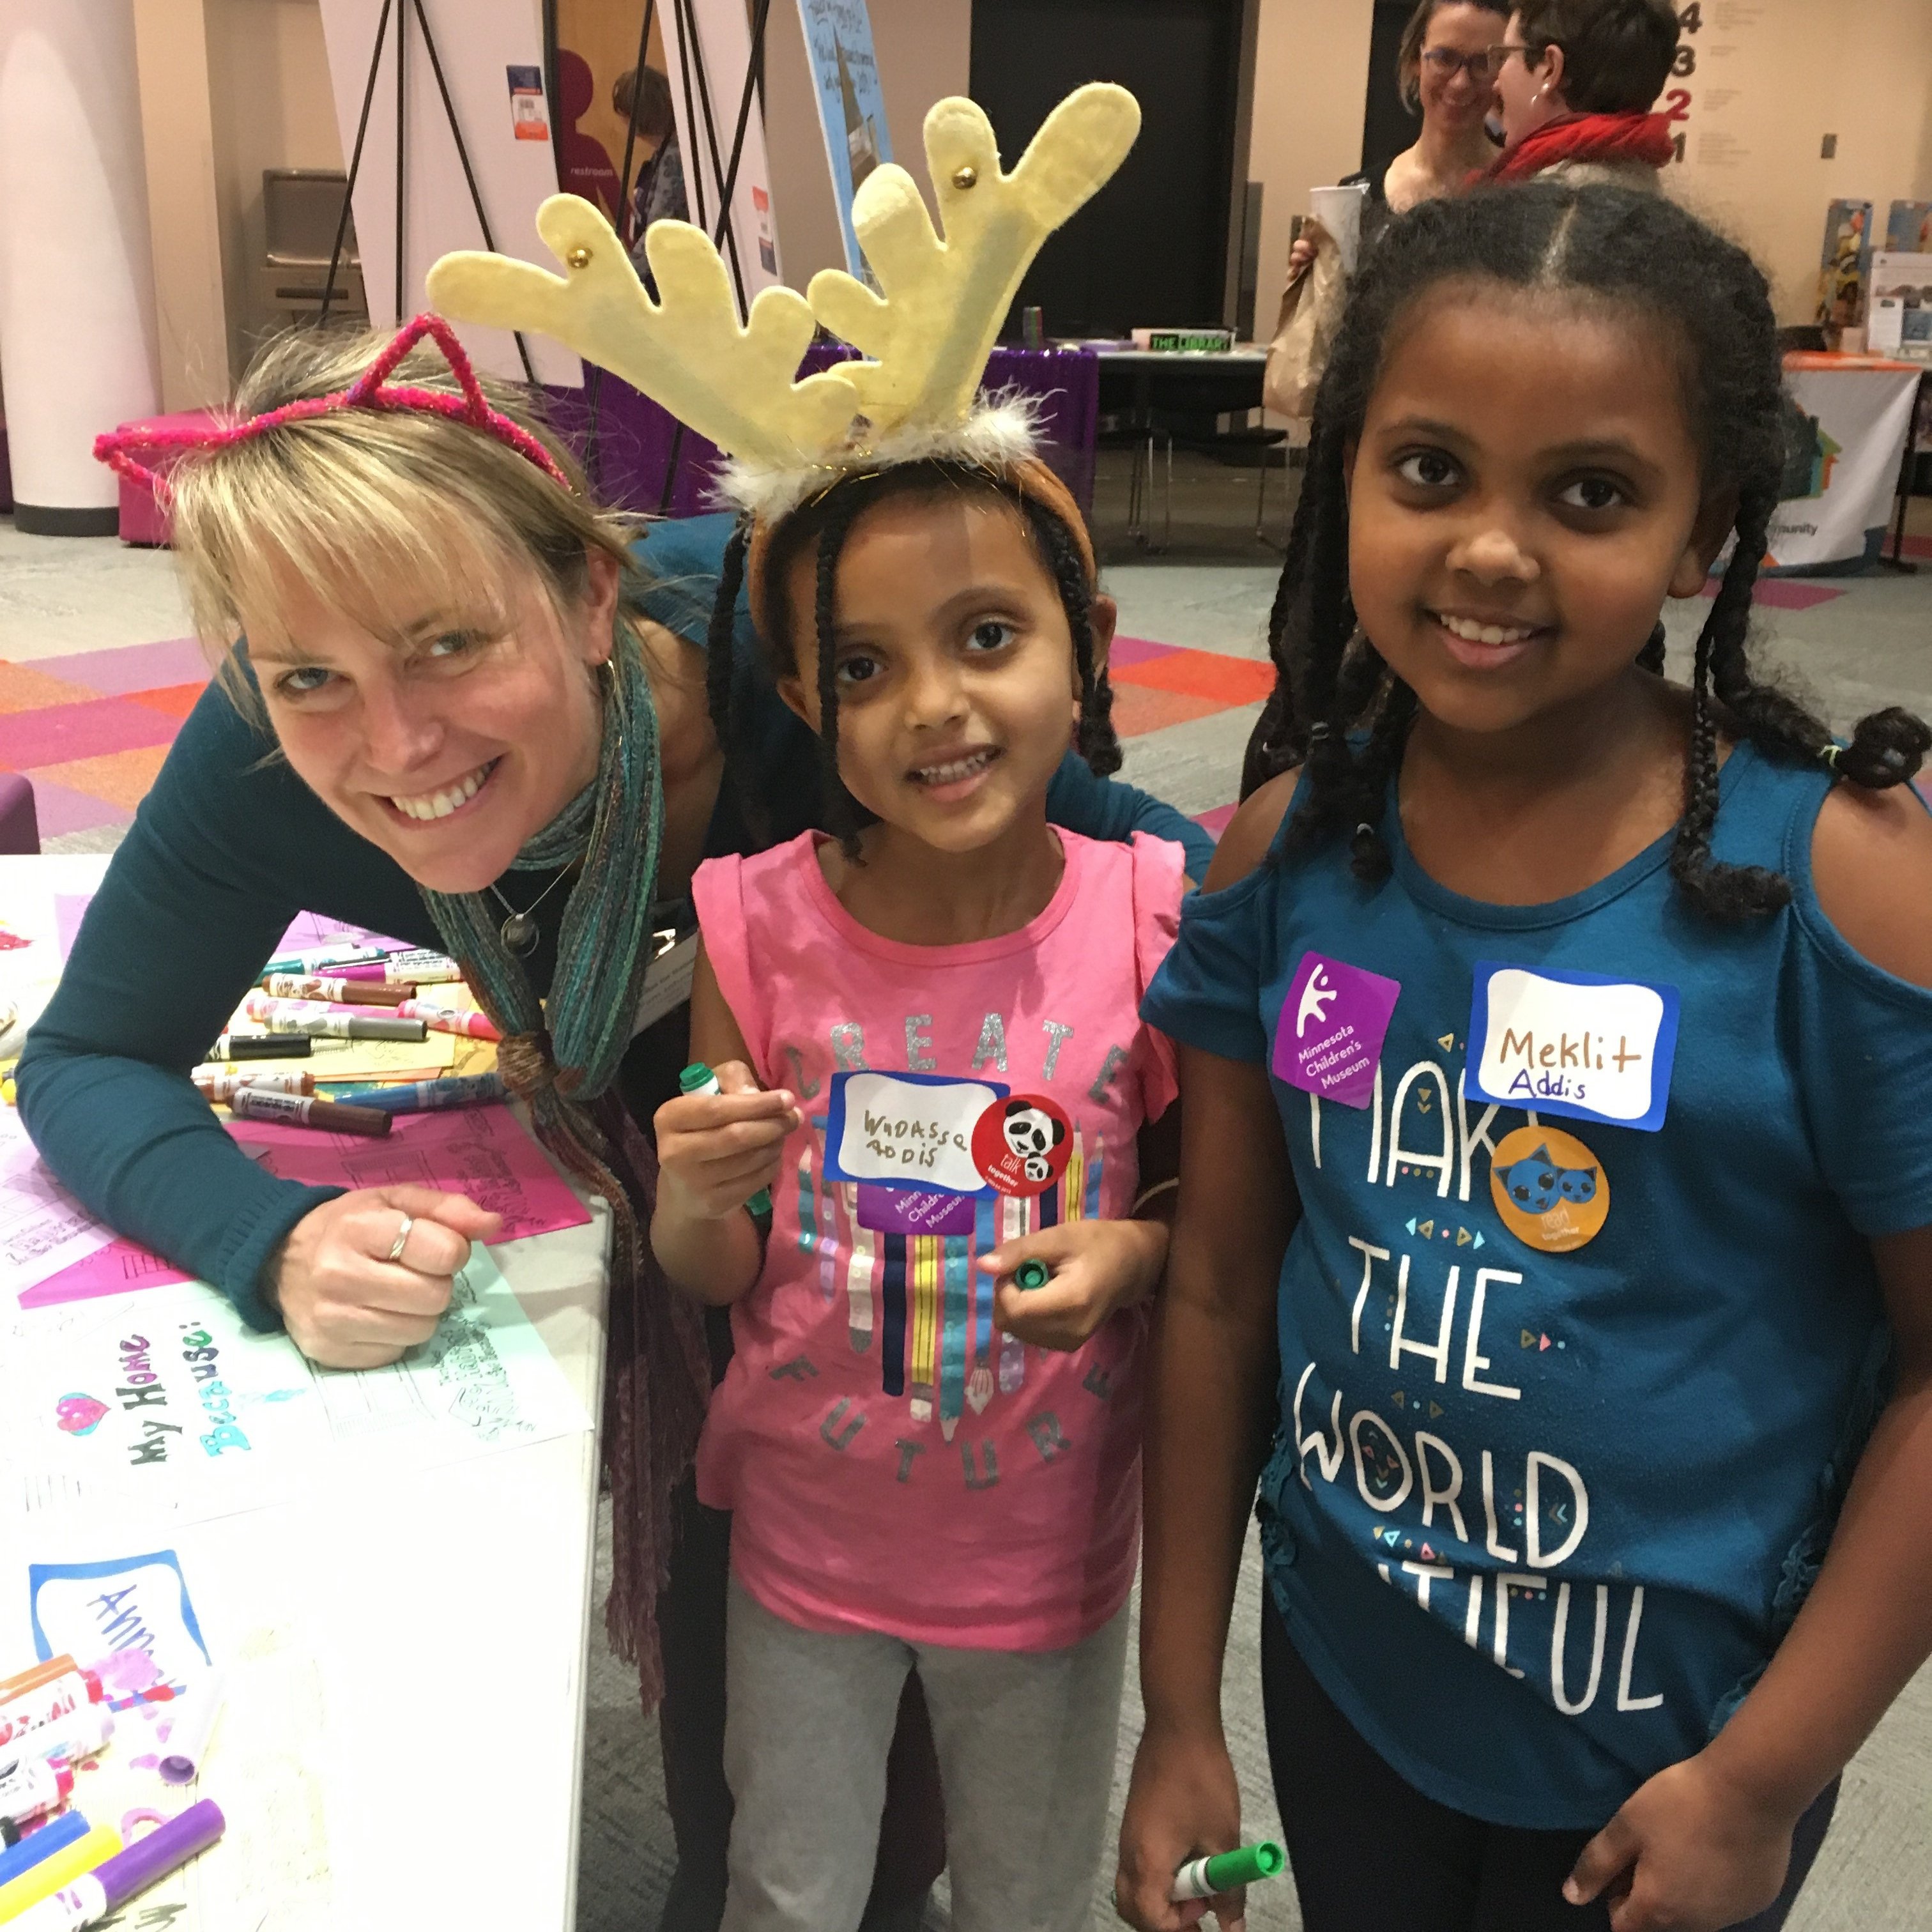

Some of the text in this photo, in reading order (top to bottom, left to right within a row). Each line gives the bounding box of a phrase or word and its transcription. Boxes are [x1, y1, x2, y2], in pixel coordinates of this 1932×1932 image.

[1677, 1, 1703, 34] 4
[1670, 44, 1696, 77] 3
[1666, 88, 1692, 121] 2
[1673, 132, 1687, 164] 1
[571, 167, 614, 176] restroom
[1152, 335, 1177, 350] THE
[1298, 1025, 1354, 1064] Minnesota
[1306, 1039, 1362, 1077] Children's
[1499, 1027, 1642, 1073] Meklit
[1321, 1057, 1370, 1089] Museum
[1508, 1068, 1586, 1100] Addis
[987, 1164, 1019, 1187] together
[1000, 1154, 1022, 1175] talk
[908, 1193, 945, 1222] Childr
[925, 1195, 965, 1229] Museu
[1348, 1235, 1523, 1401] THE
[768, 1354, 1112, 1491] FUTURE
[1294, 1361, 1590, 1569] WORLD
